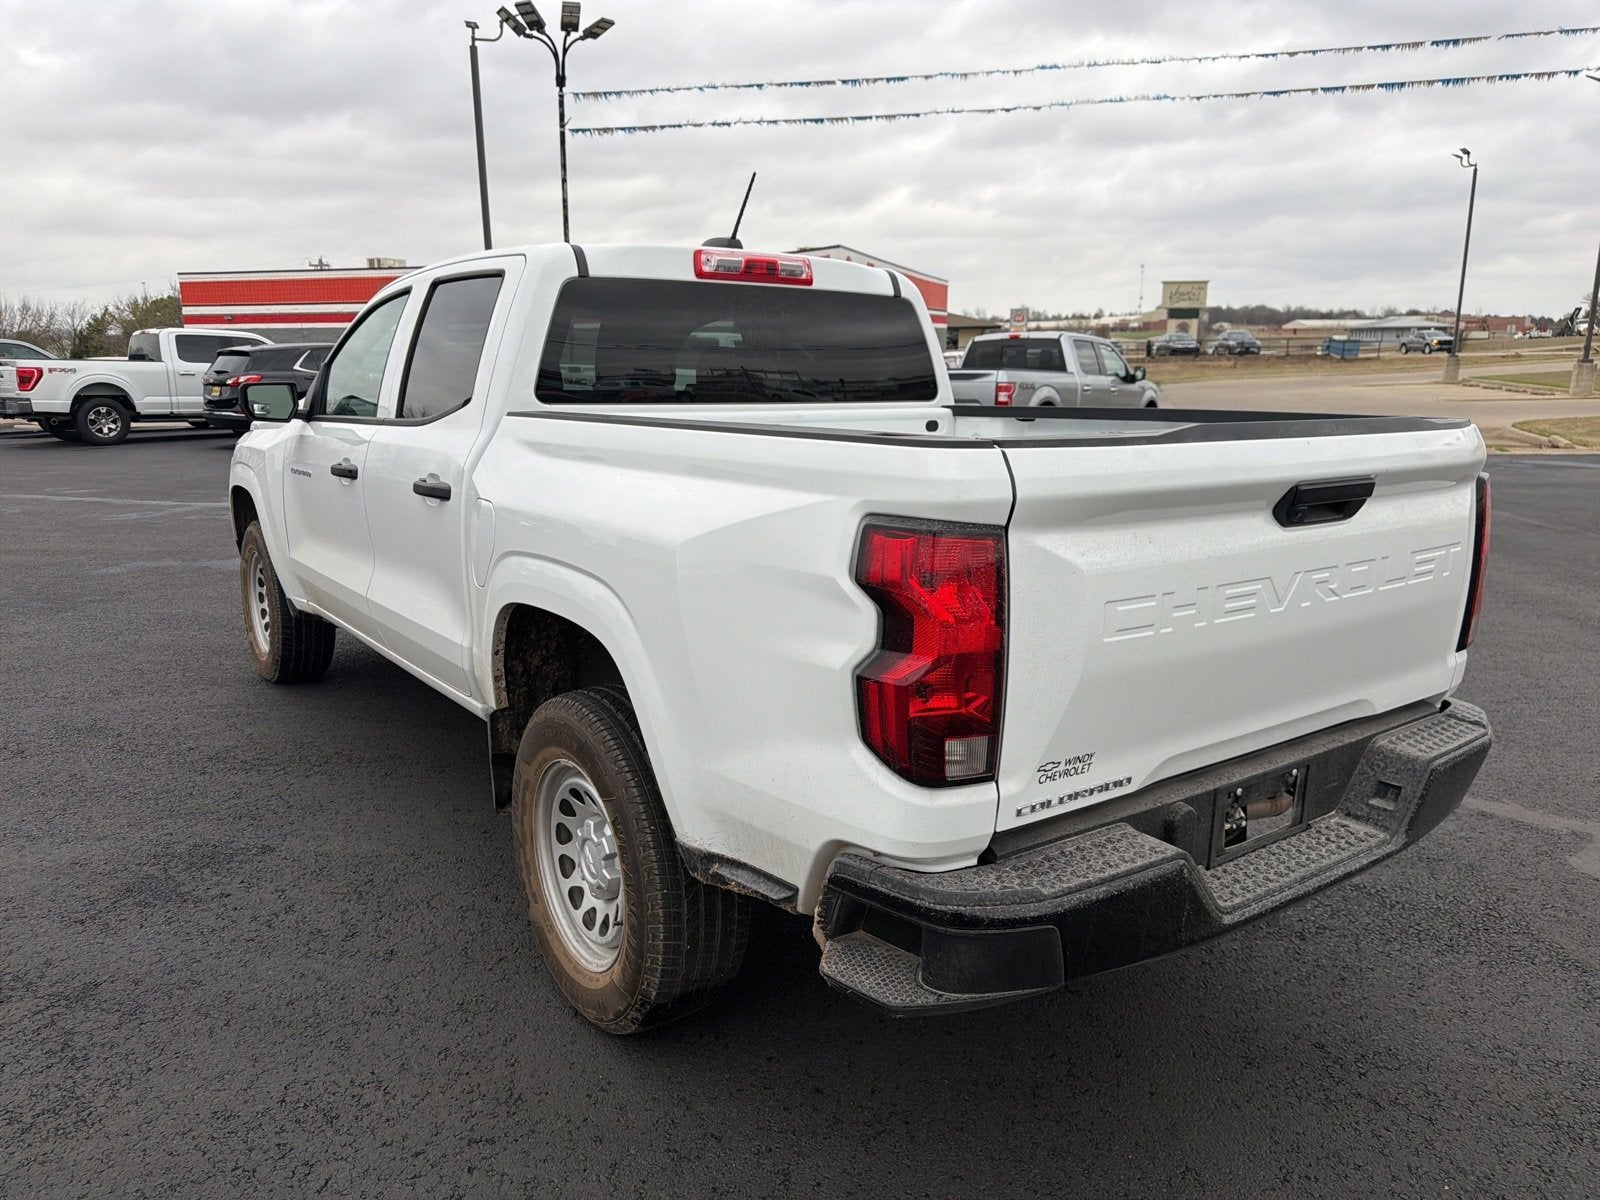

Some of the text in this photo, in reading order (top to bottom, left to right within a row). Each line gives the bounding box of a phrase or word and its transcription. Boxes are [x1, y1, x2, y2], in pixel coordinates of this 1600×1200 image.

[1103, 541, 1462, 642] CHEVROLET
[1038, 762, 1093, 785] CHEVROLET
[1064, 752, 1096, 768] WINDY
[1015, 776, 1133, 817] COLORADO
